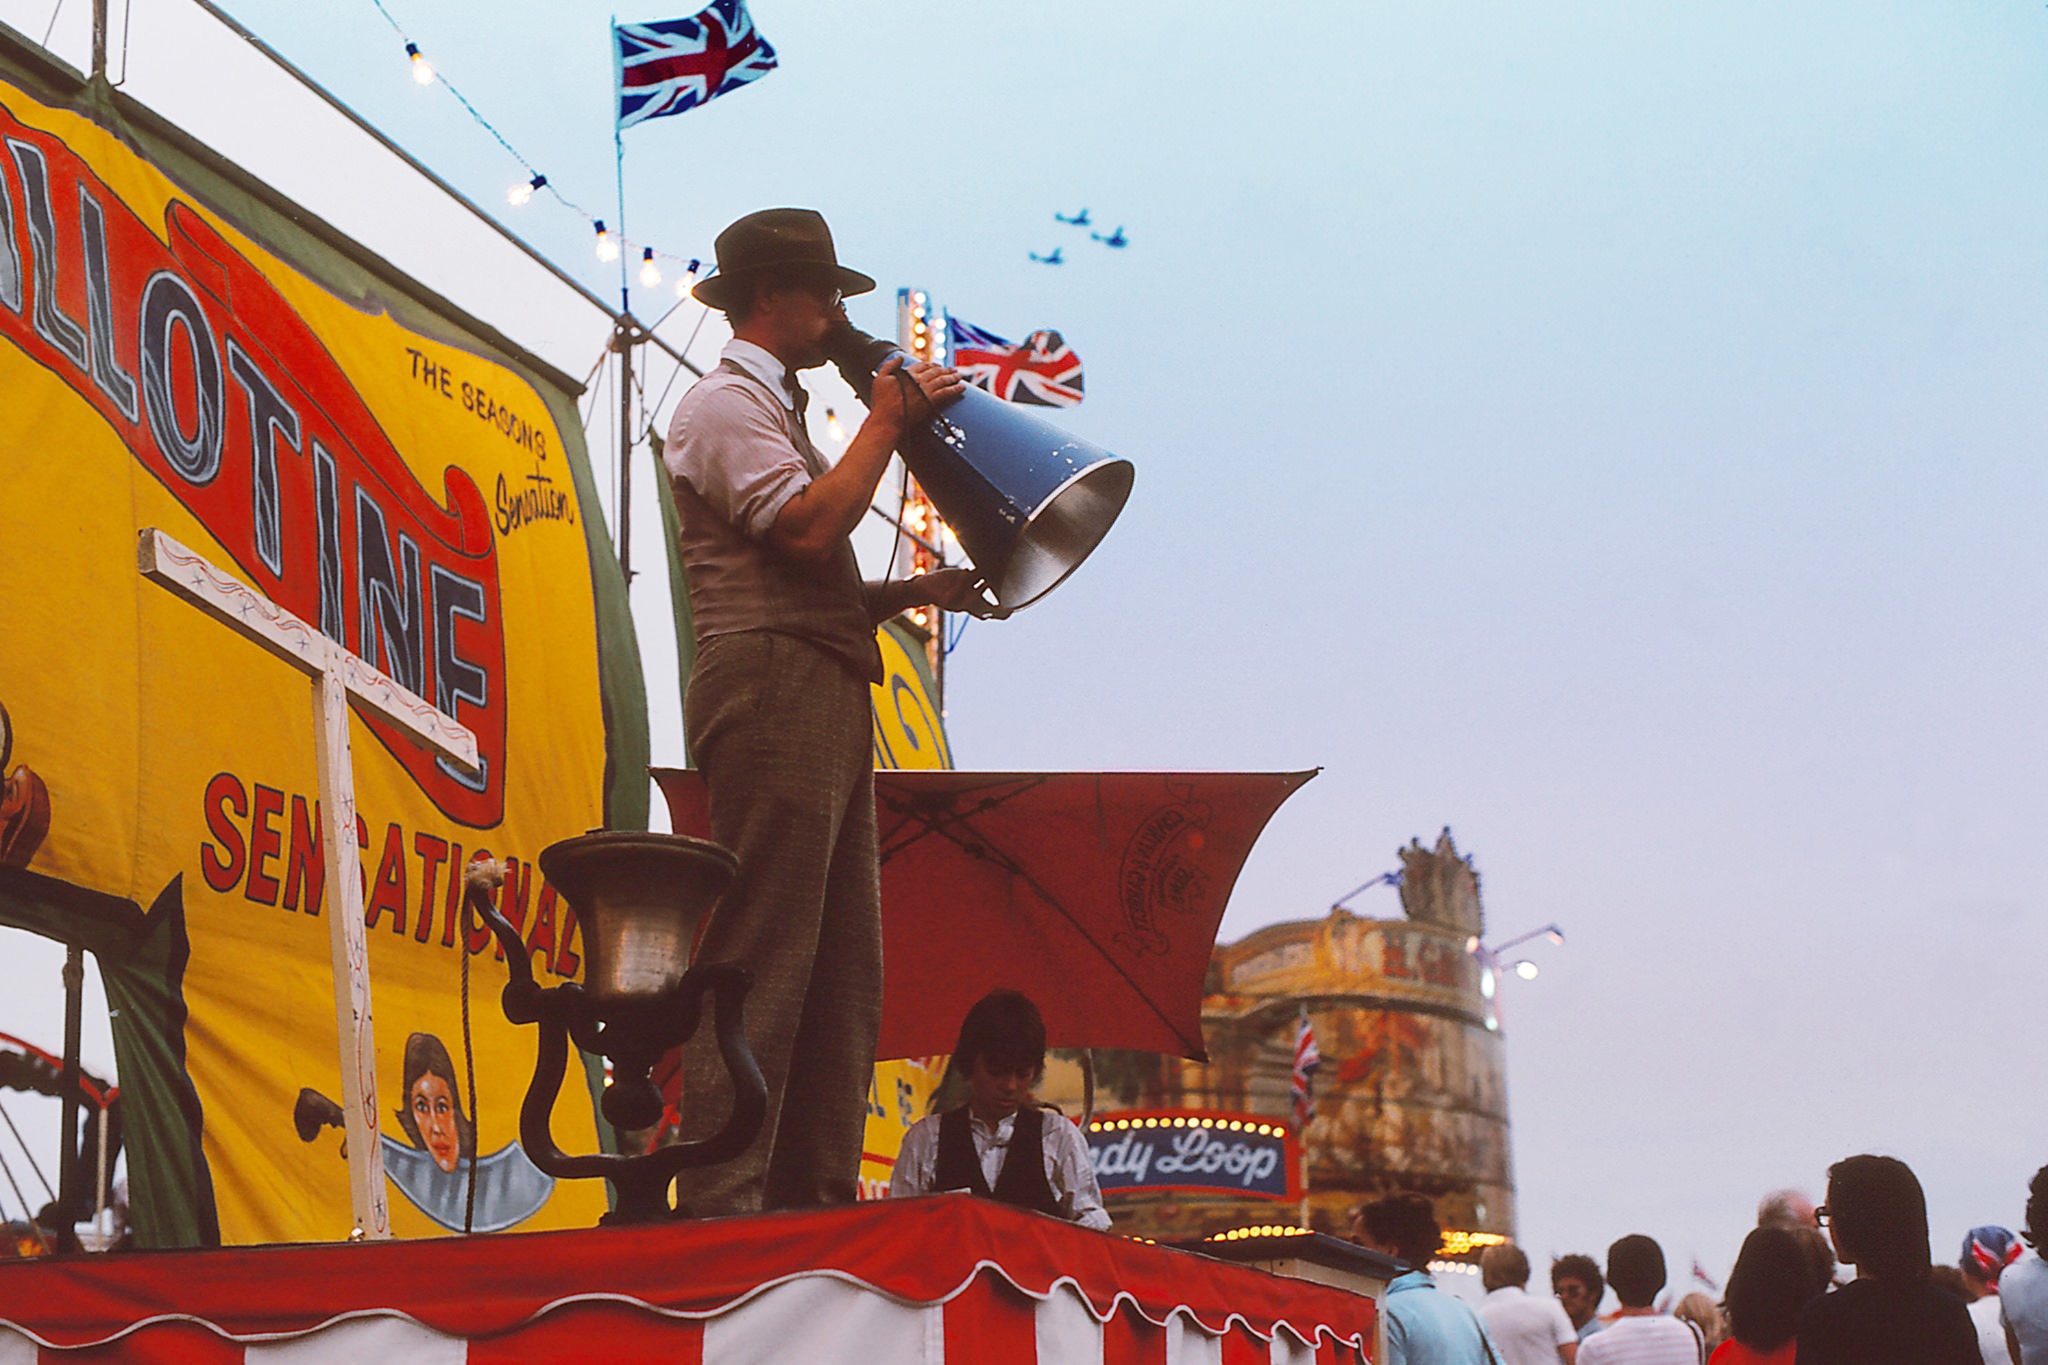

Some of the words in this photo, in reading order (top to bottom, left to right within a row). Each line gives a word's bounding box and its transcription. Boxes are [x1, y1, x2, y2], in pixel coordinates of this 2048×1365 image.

[405, 347, 453, 400] THE
[461, 381, 547, 461] SEASONS
[495, 463, 574, 536] Sensation
[1155, 1127, 1278, 1187] Loop
